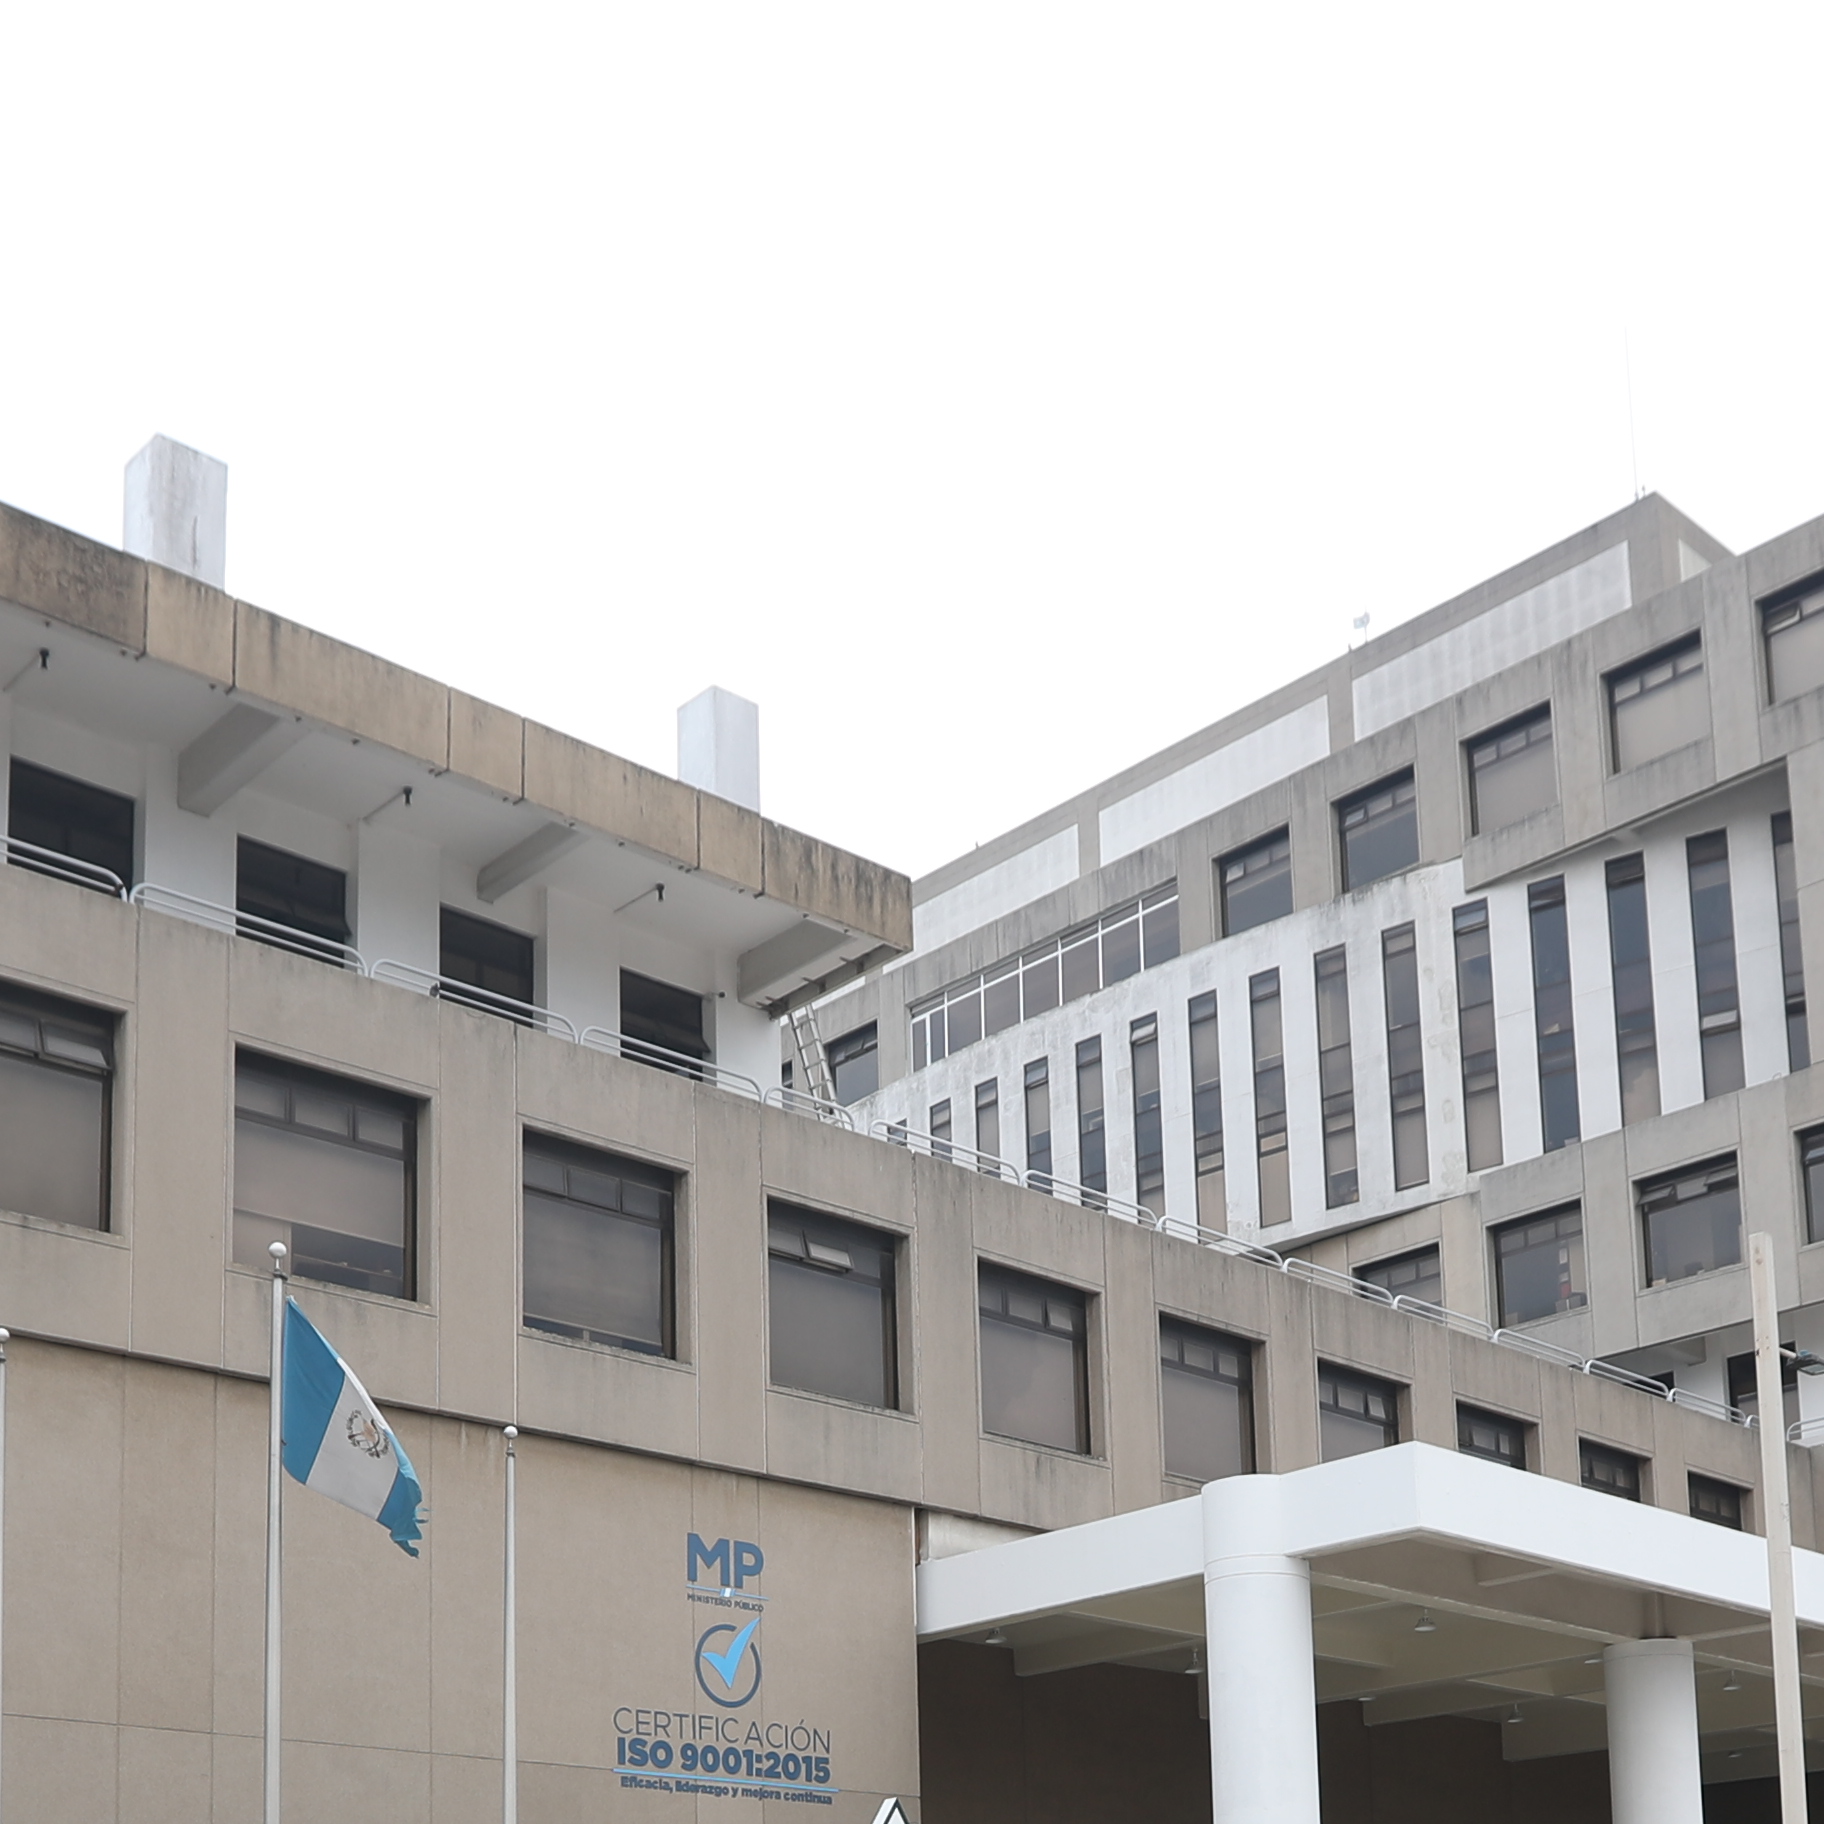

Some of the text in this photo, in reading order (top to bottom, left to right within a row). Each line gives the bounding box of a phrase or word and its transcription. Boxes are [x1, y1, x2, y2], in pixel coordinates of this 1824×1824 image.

[686, 1532, 764, 1589] MP
[687, 1593, 733, 1608] MINISTERIO
[613, 1707, 831, 1754] CERTIFICACIÓN
[617, 1737, 831, 1784] ISO 9001:2015
[620, 1775, 833, 1805] Eficacia, liderazgo y mejora continua
